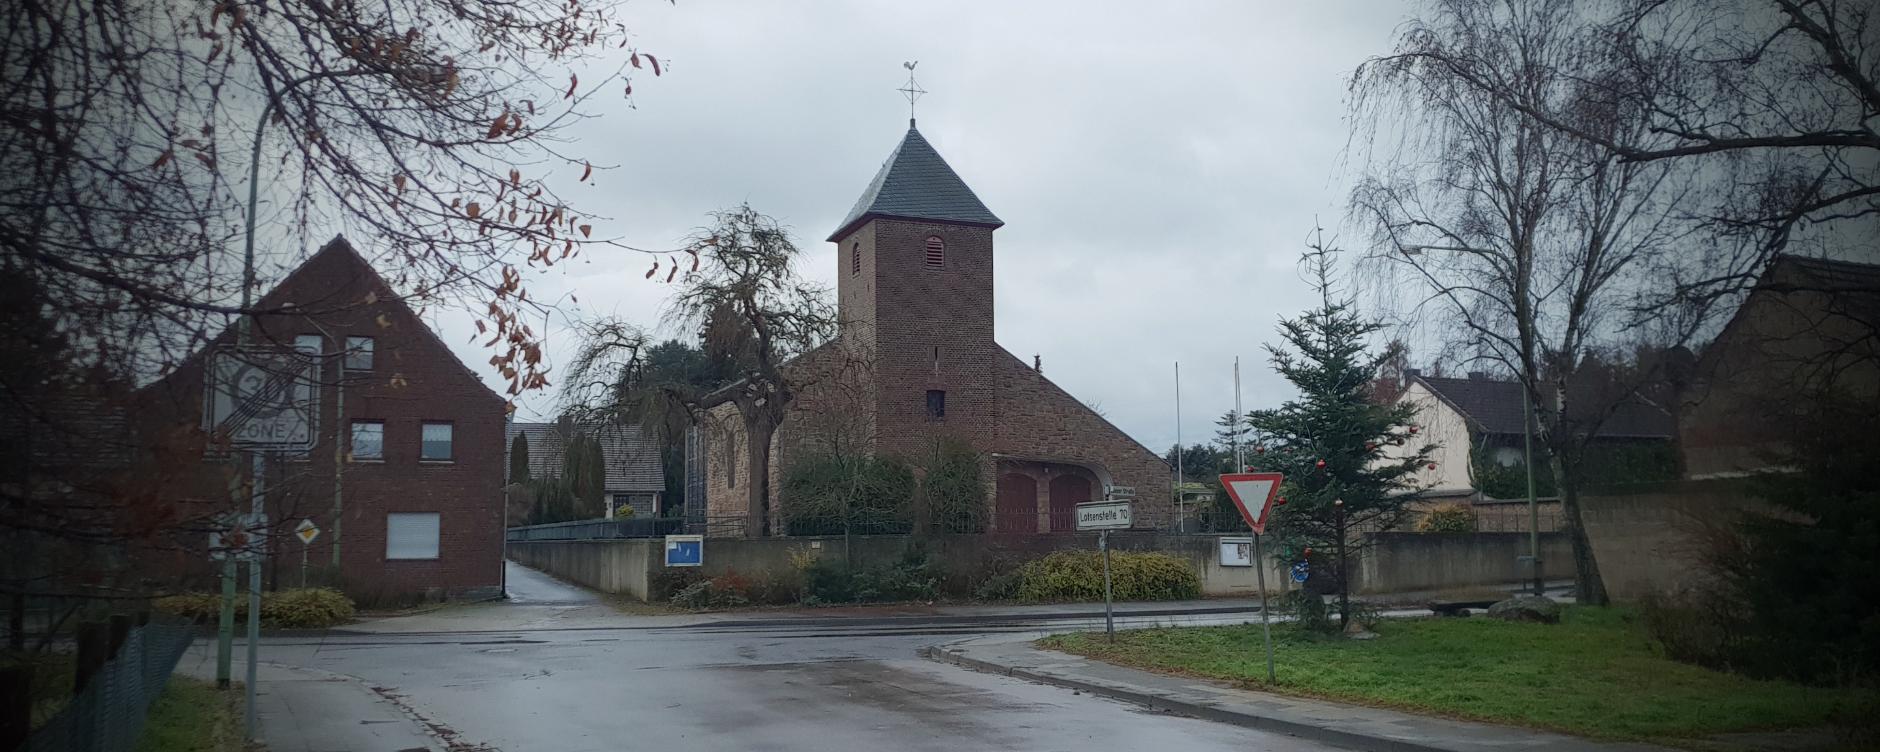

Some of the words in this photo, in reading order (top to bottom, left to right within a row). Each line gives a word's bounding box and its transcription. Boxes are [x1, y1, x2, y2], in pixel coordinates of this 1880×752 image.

[236, 423, 286, 438] ZONE
[1080, 510, 1117, 521] Lotsenstelle
[1119, 509, 1128, 519] 70
